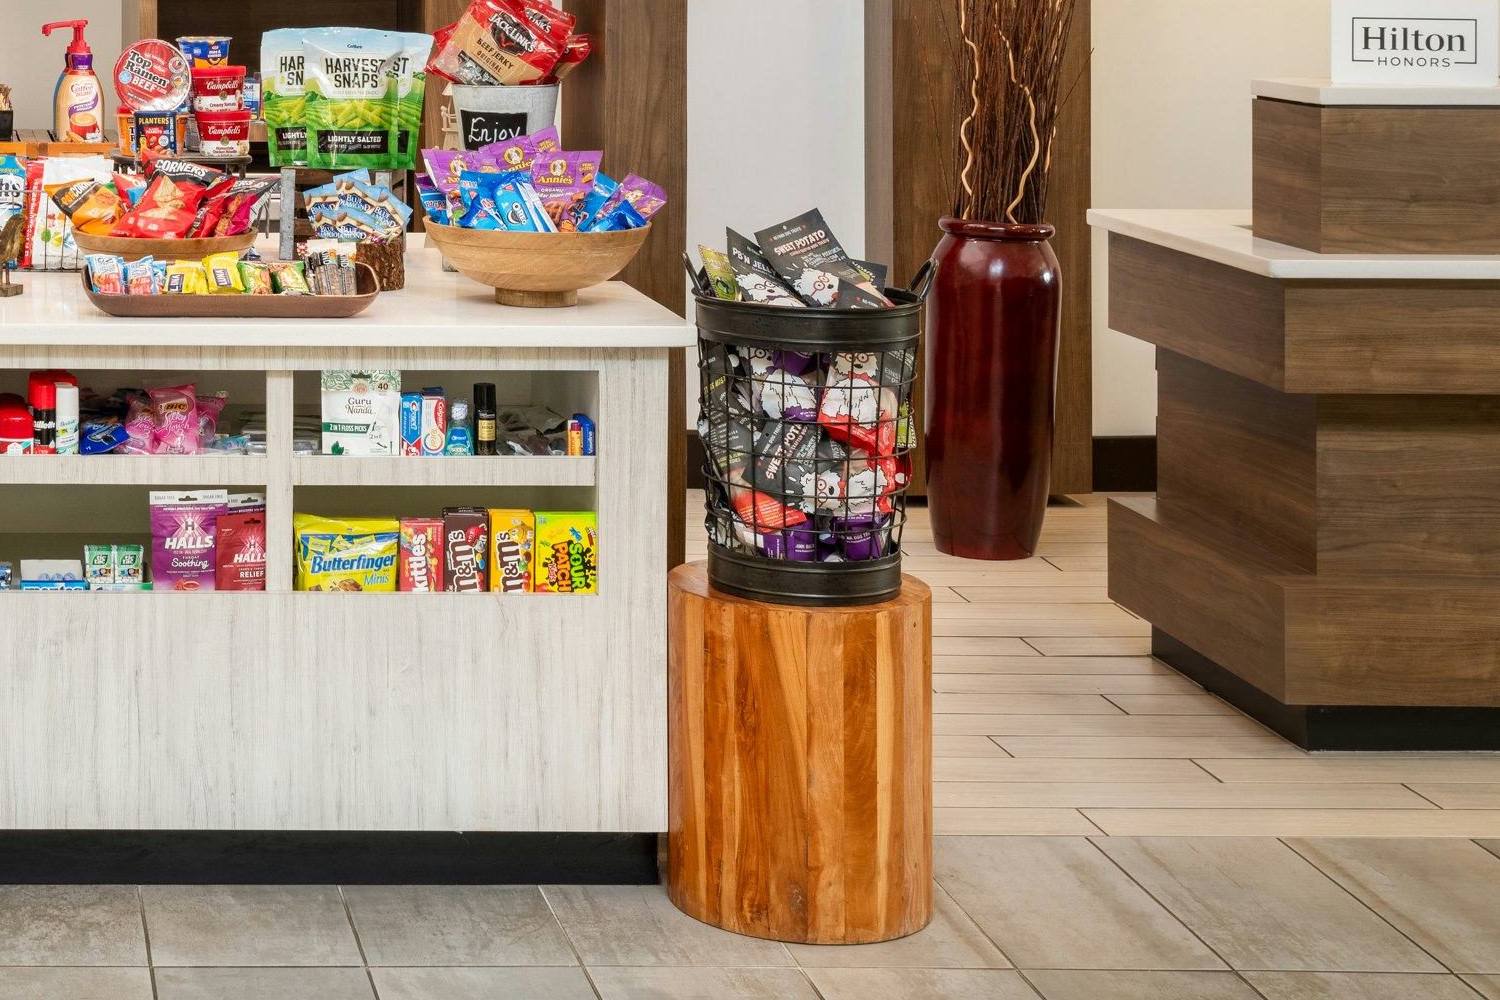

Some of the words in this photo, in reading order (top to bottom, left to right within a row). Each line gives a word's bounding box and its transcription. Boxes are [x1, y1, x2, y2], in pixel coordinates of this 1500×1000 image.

[1362, 27, 1466, 51] Hilton
[130, 50, 151, 69] Top
[476, 38, 495, 54] BEEF
[493, 52, 514, 69] JERKY
[476, 51, 502, 73] ORIGINAL
[1378, 57, 1450, 67] HONORS
[125, 60, 169, 87] Ramen
[325, 58, 386, 74] HARVEST
[71, 83, 93, 93] Coffee
[131, 77, 156, 92] BEEF
[207, 81, 239, 90] Campbell's
[334, 74, 378, 89] SNAPS
[138, 117, 169, 125] PLANTERS
[208, 126, 241, 135] Campbell's
[468, 117, 521, 143] Enjoy
[538, 175, 573, 185] Annie's
[511, 203, 527, 225] OREO
[774, 242, 796, 255] SWEET
[794, 230, 825, 248] POTATO
[345, 405, 373, 414] Nanda
[172, 558, 209, 569] Soothing
[311, 552, 396, 575] Butterfinger
[412, 533, 426, 592] kittles
[554, 541, 572, 592] PATCH
[569, 542, 586, 588] SOUR
[364, 574, 390, 586] Minis
